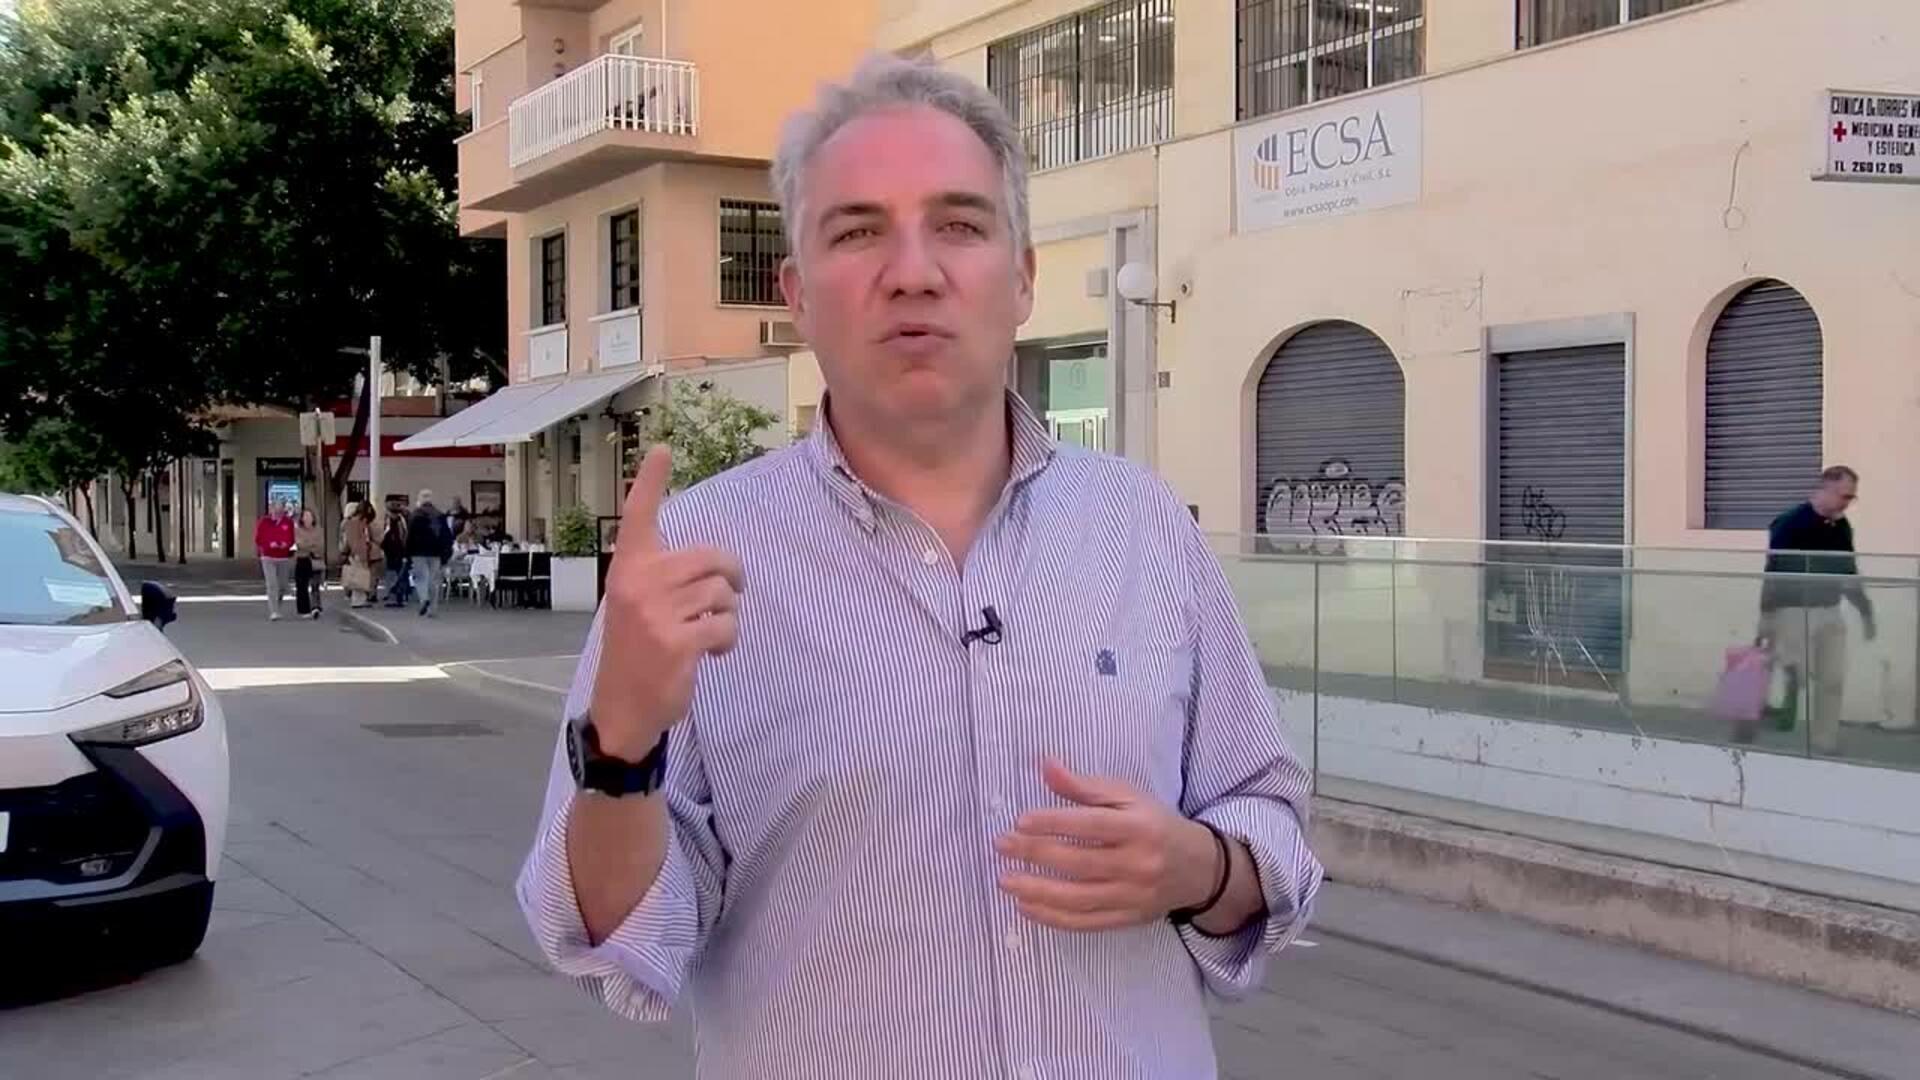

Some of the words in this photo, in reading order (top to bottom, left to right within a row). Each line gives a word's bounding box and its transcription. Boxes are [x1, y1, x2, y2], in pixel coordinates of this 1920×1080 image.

[1831, 96, 1864, 116] CLINICA
[1852, 121, 1894, 138] MEDICINA
[1286, 109, 1395, 178] ECSA
[1868, 141, 1874, 156] Y
[1876, 141, 1916, 157] ESTETICA
[1876, 162, 1887, 174] 12
